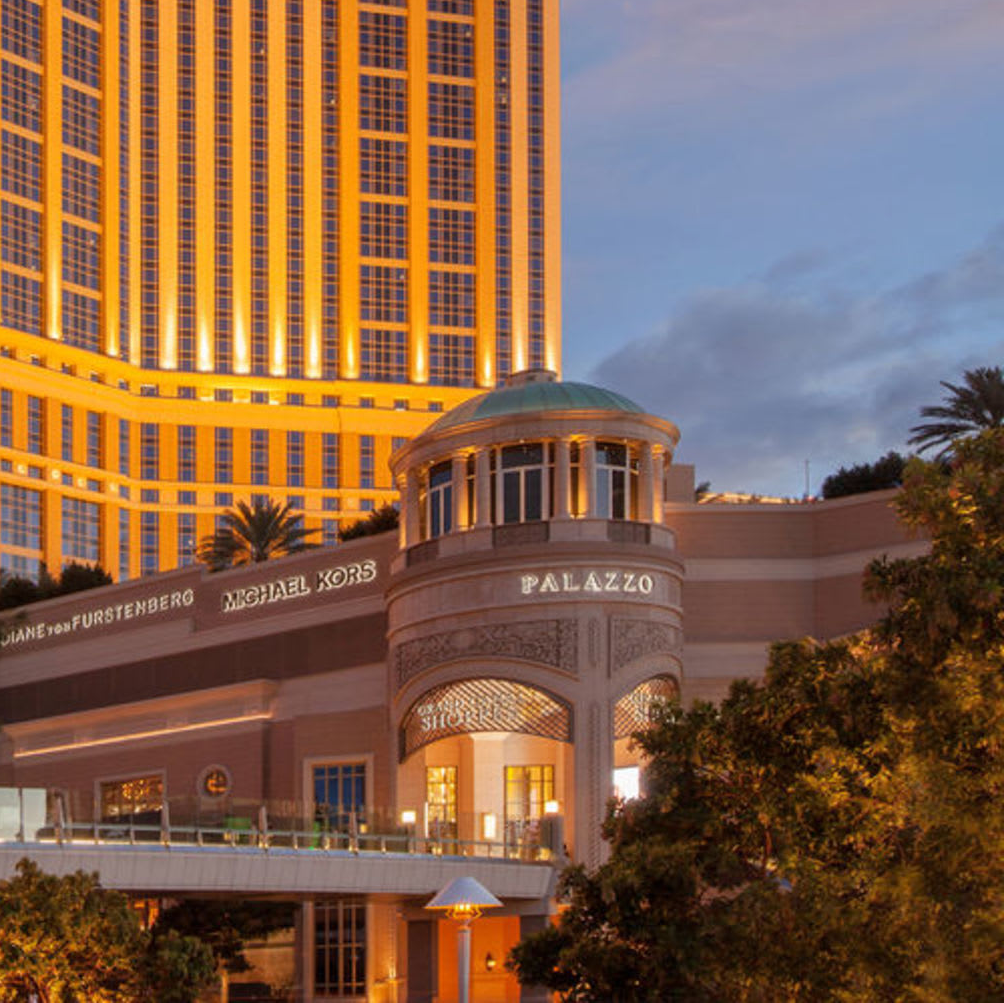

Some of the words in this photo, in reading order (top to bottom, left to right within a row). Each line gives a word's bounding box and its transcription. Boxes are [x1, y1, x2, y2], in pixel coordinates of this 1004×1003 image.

[222, 576, 310, 612] MICHAEL
[316, 560, 376, 593] KORS
[521, 571, 653, 594] PALAZZO
[72, 588, 194, 629] FURSTENBERG
